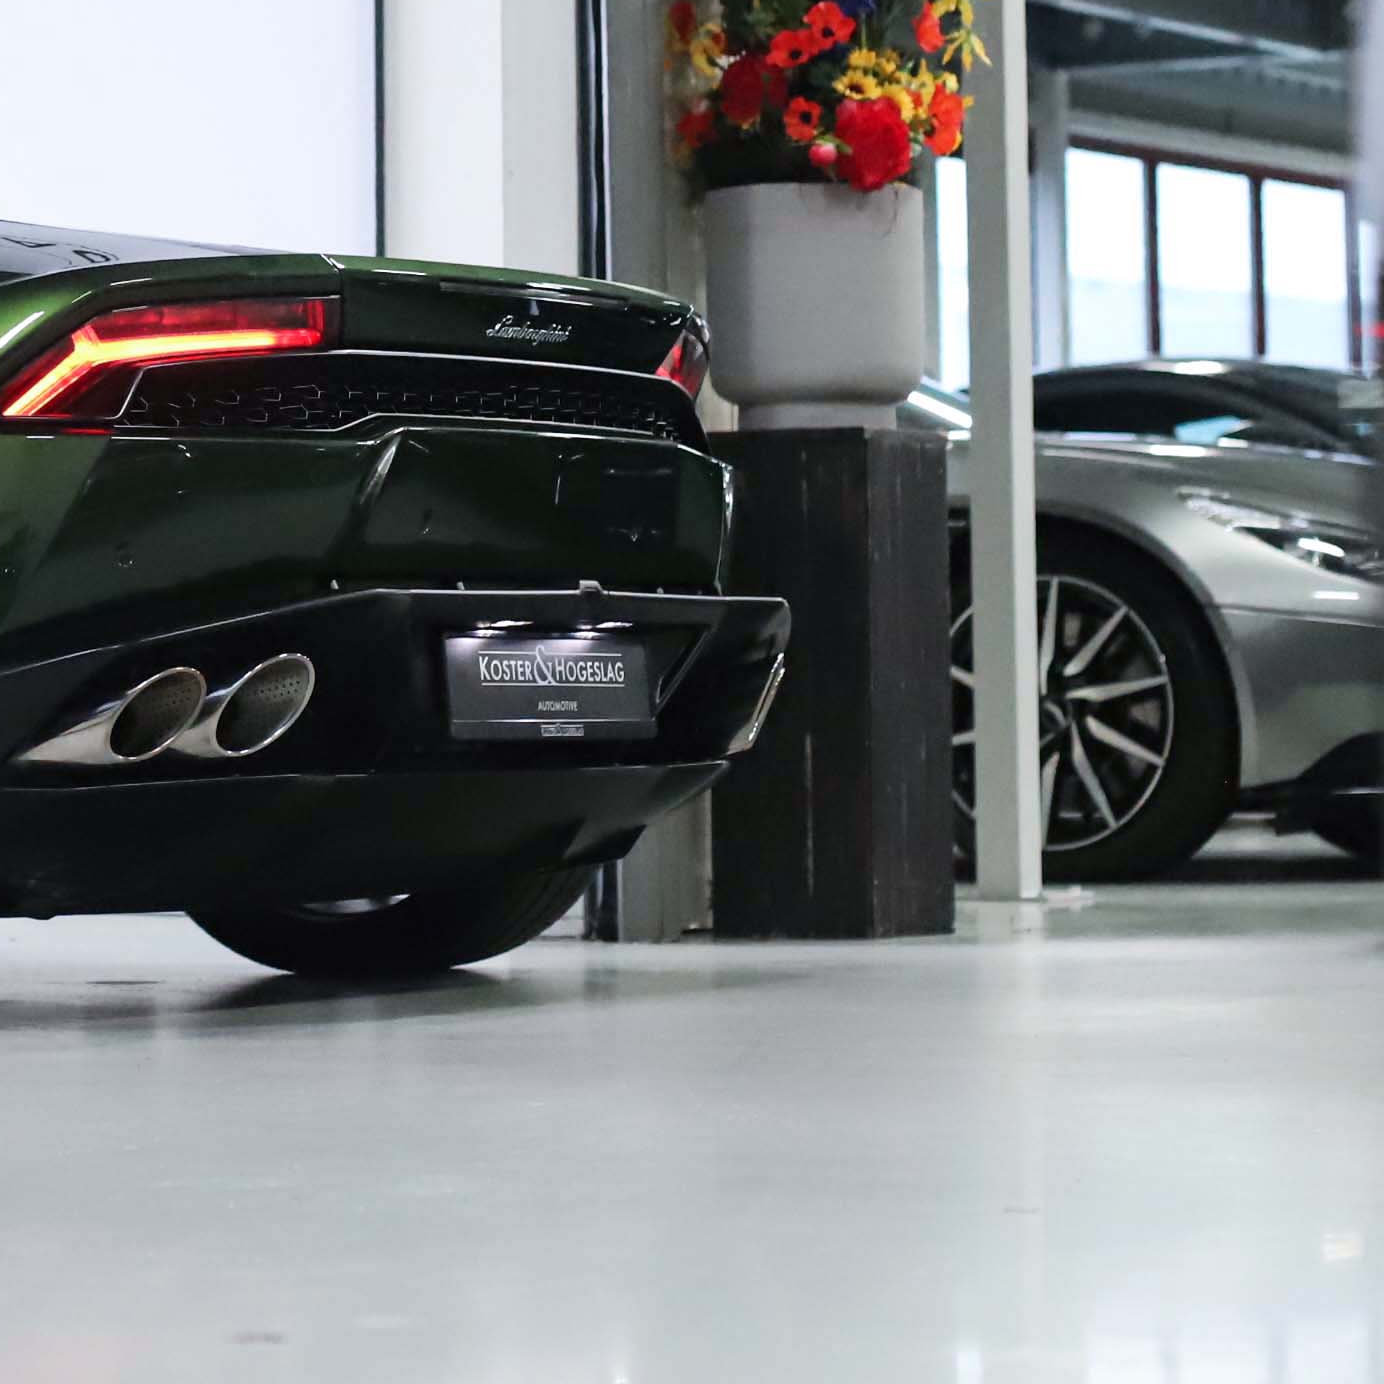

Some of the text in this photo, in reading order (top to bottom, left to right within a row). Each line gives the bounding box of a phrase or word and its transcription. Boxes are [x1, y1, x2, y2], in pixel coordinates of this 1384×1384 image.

[478, 656, 533, 681] KOSTER
[555, 657, 625, 683] HOGESLAG
[537, 700, 578, 712] AUTOMOTIVE
